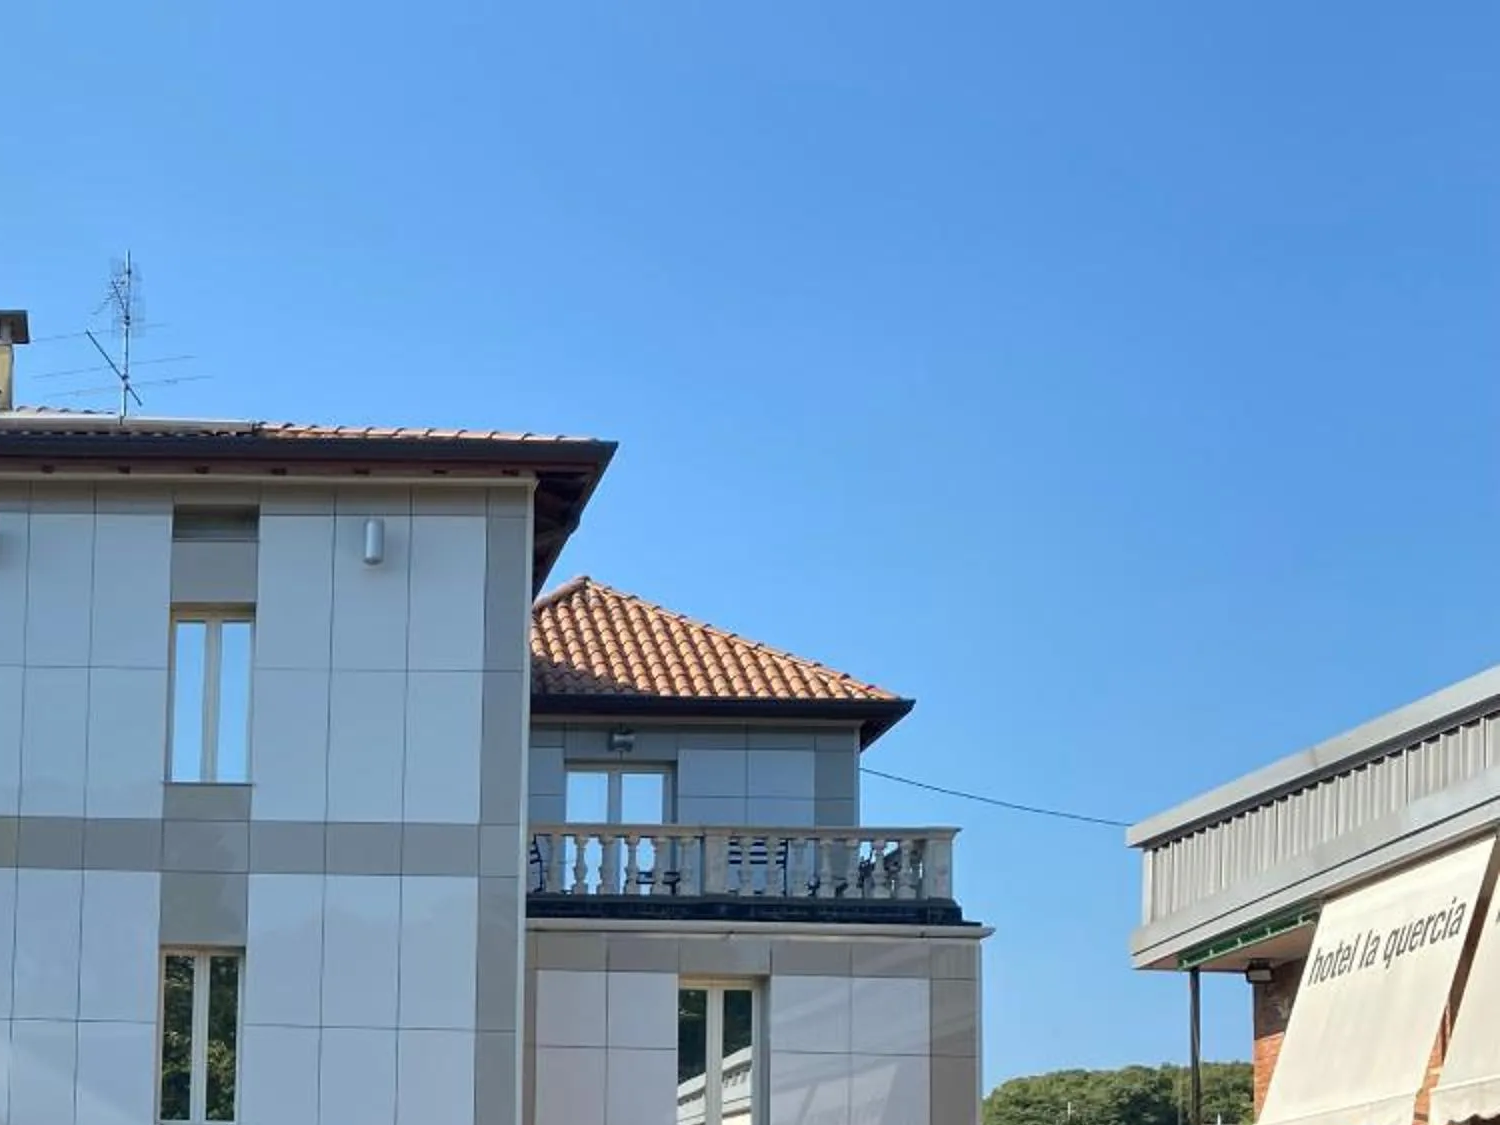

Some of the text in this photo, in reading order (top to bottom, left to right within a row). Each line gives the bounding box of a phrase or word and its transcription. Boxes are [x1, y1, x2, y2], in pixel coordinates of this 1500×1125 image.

[1308, 897, 1467, 986] hotel la quercia
